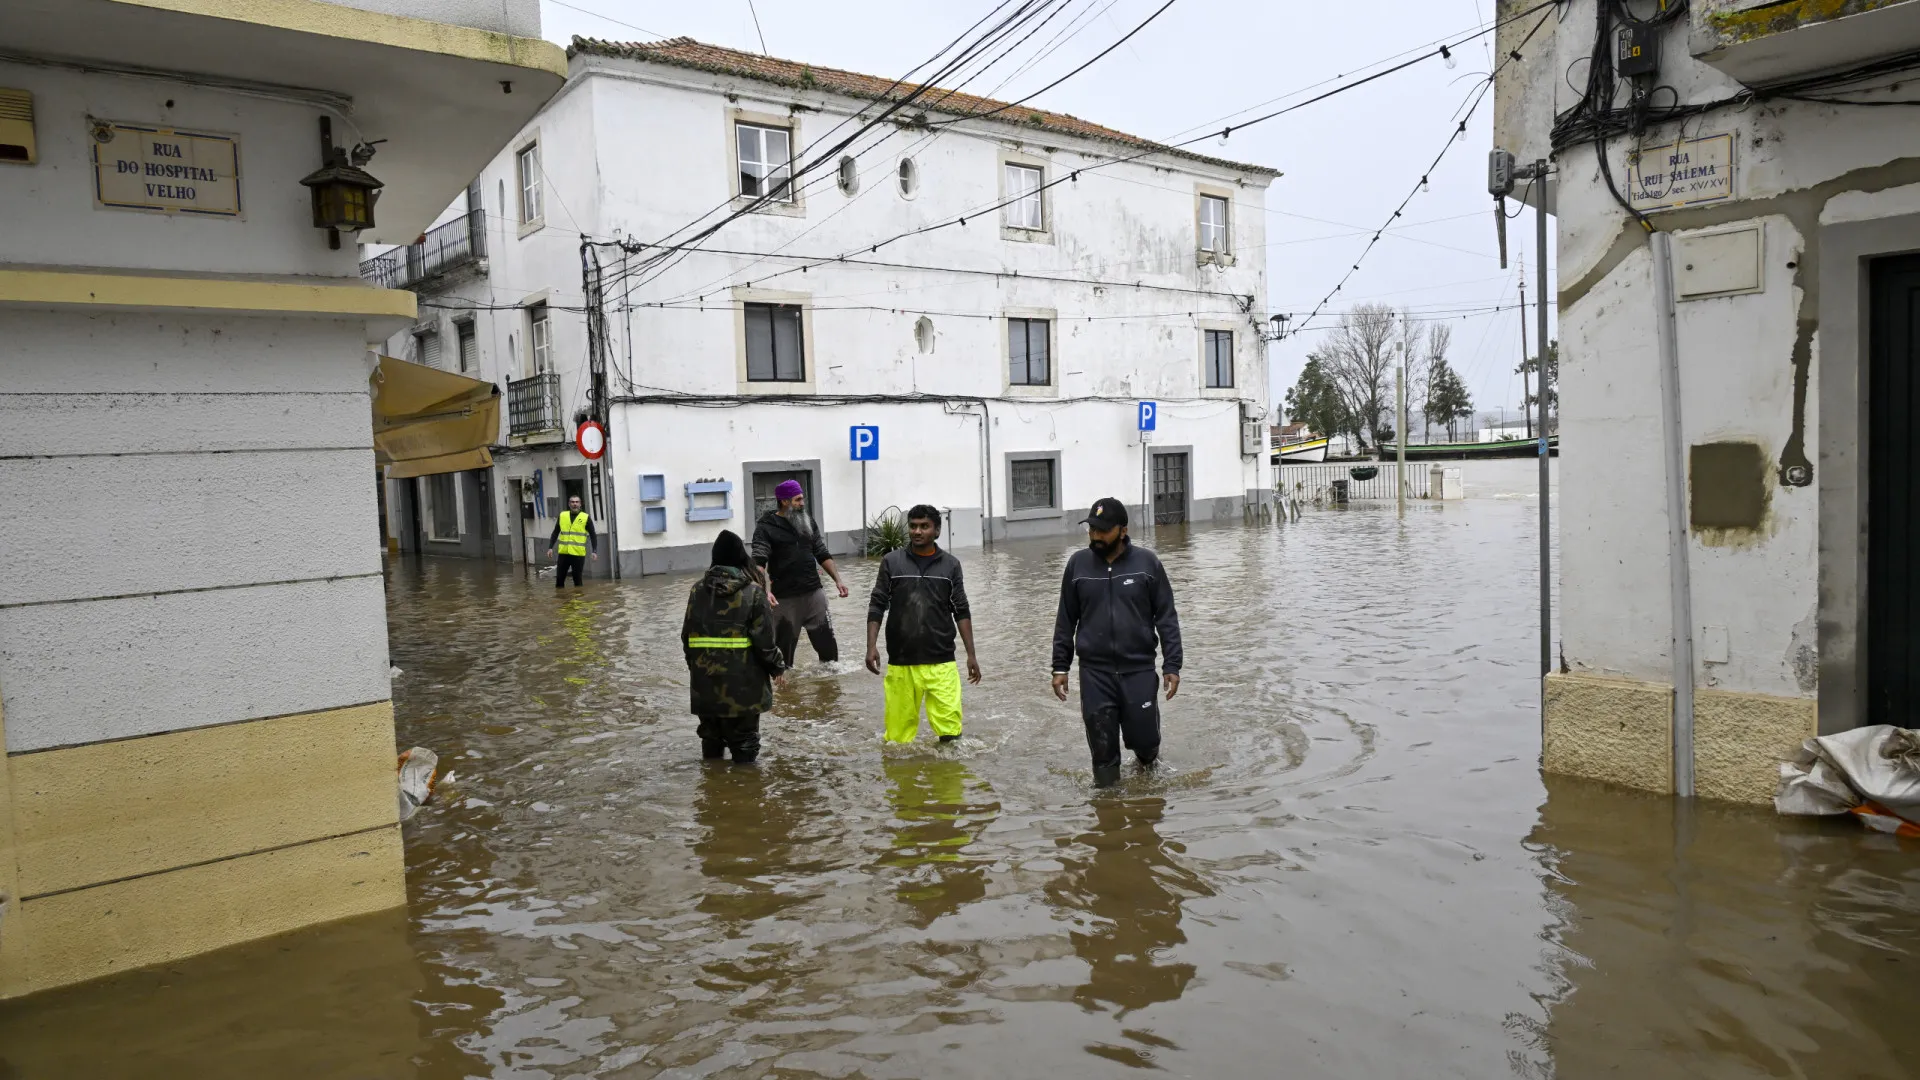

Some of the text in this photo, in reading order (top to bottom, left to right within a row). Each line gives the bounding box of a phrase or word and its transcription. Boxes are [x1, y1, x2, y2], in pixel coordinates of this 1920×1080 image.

[152, 142, 182, 158] RUA
[1669, 153, 1690, 166] RUA
[117, 159, 217, 182] DO HOSPITAL
[1644, 165, 1716, 187] RUI SALEMA
[146, 183, 196, 200] VELHO
[1690, 177, 1728, 192] XV/XVI
[1142, 404, 1153, 428] P
[856, 428, 873, 458] P
